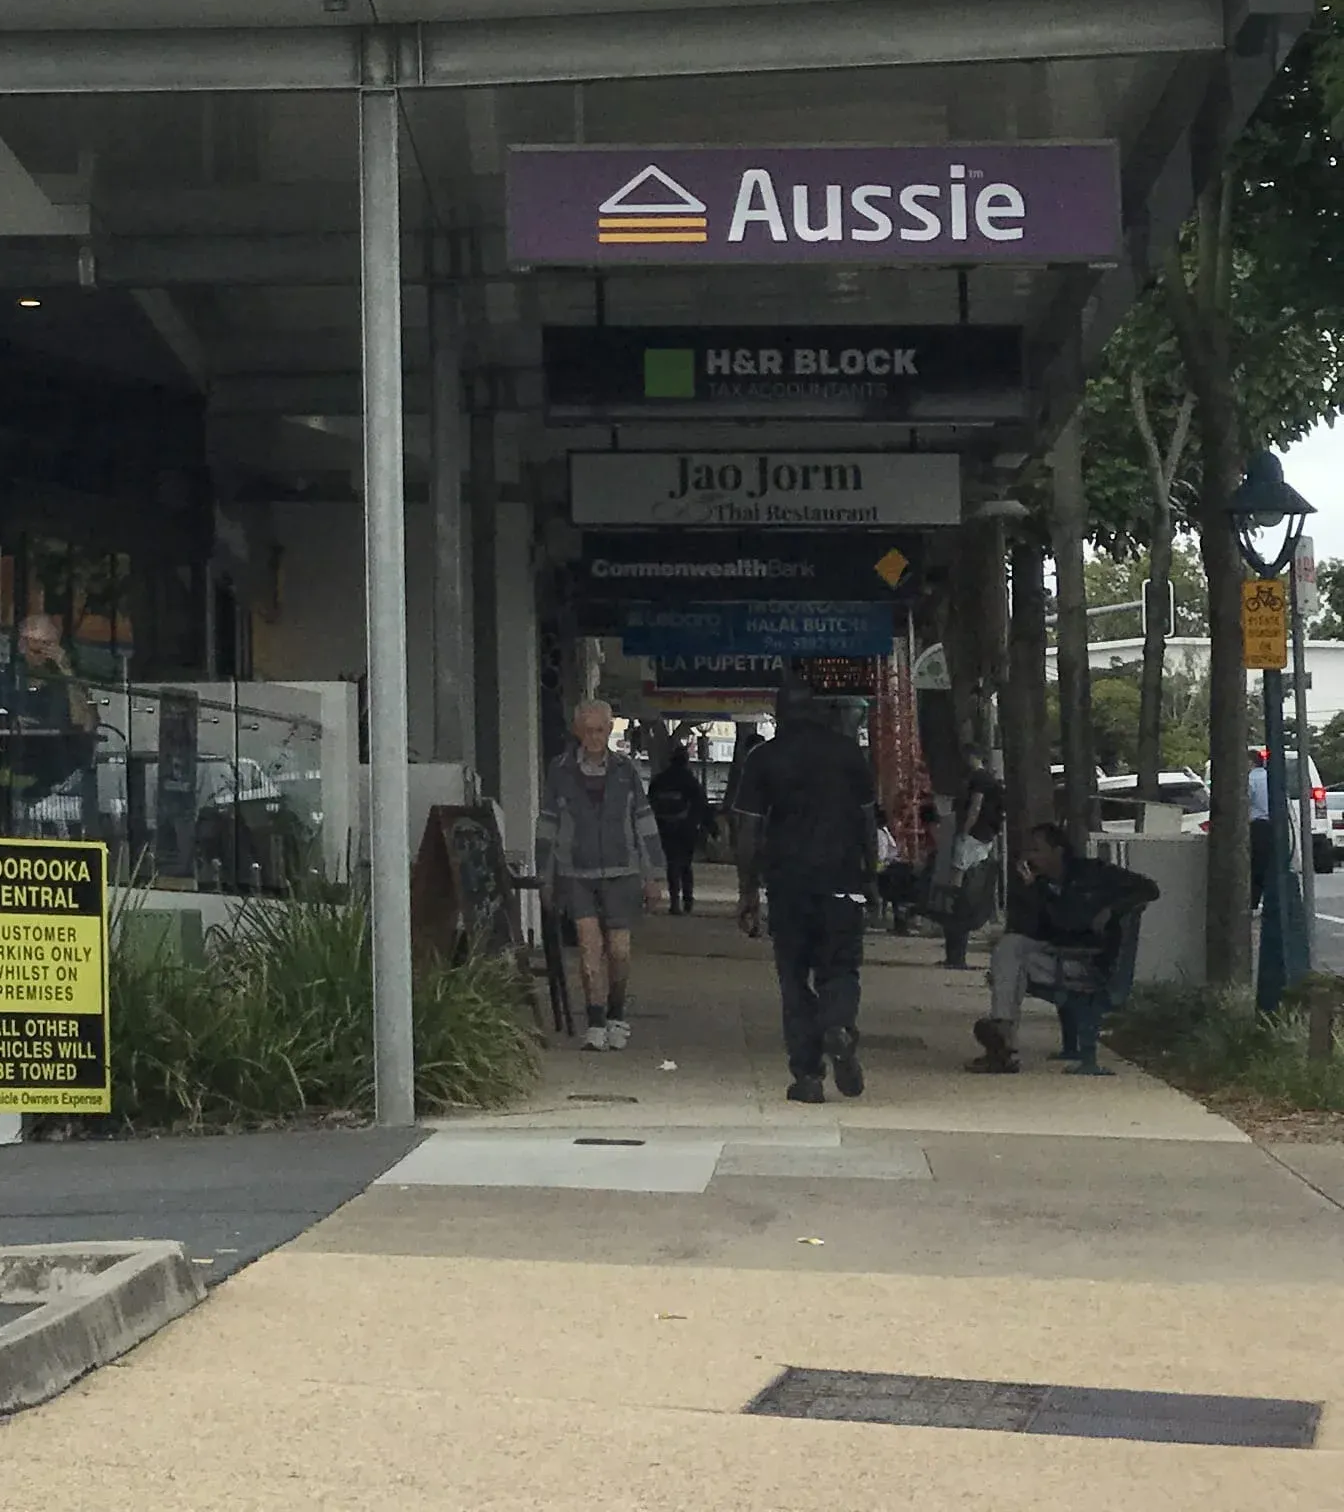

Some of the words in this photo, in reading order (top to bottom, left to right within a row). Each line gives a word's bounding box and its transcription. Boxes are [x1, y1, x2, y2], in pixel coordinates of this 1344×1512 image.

[727, 164, 1025, 242] Aussie
[705, 348, 784, 376] H&R
[794, 348, 919, 376] BLOCK
[708, 382, 742, 399] TAX
[748, 382, 888, 399] ACCOUNTANTS
[669, 455, 743, 498] Jao
[747, 455, 863, 498] Jorm
[716, 501, 759, 521] Thai
[766, 502, 878, 521] Restaurant
[694, 654, 784, 671] PUPETTA
[51, 946, 92, 963] ONLY
[56, 966, 78, 982] ON
[25, 1020, 79, 1038] OTHER
[58, 1041, 96, 1059] WILL
[19, 1063, 77, 1081] TOWED
[21, 1092, 59, 1105] Owners
[62, 1092, 103, 1108] Expense
